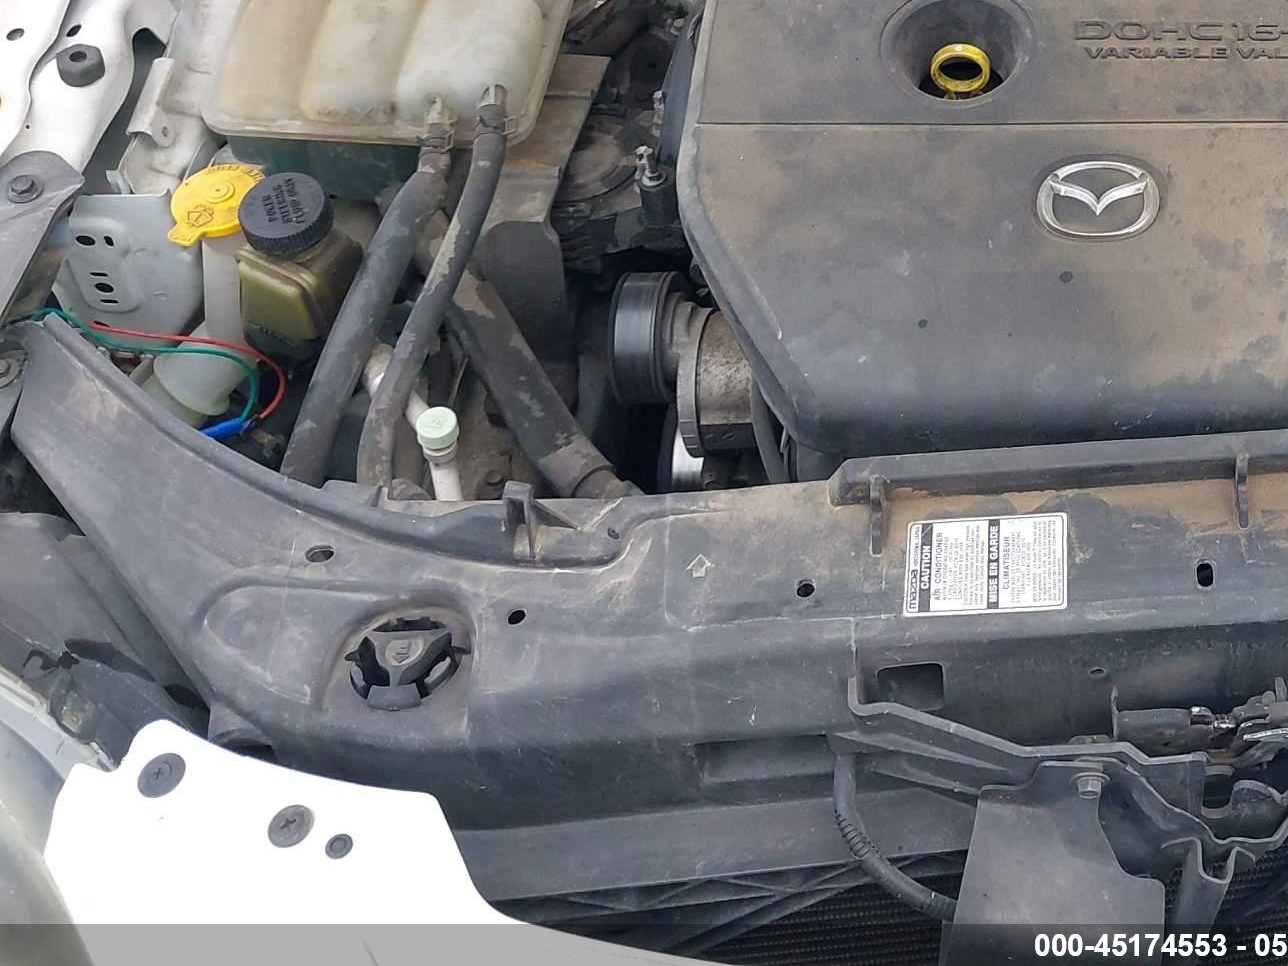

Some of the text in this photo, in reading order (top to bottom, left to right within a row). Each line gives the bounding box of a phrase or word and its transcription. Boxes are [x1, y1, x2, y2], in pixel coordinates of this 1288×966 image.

[1074, 20, 1223, 42] DOHC
[1084, 46, 1228, 60] VARIABLE
[921, 545, 931, 590] CAUTION
[933, 532, 943, 601] AIR CONDITIONER
[988, 525, 999, 603] MISE EN GARDE
[1002, 536, 1010, 590] CLIMATISEUR
